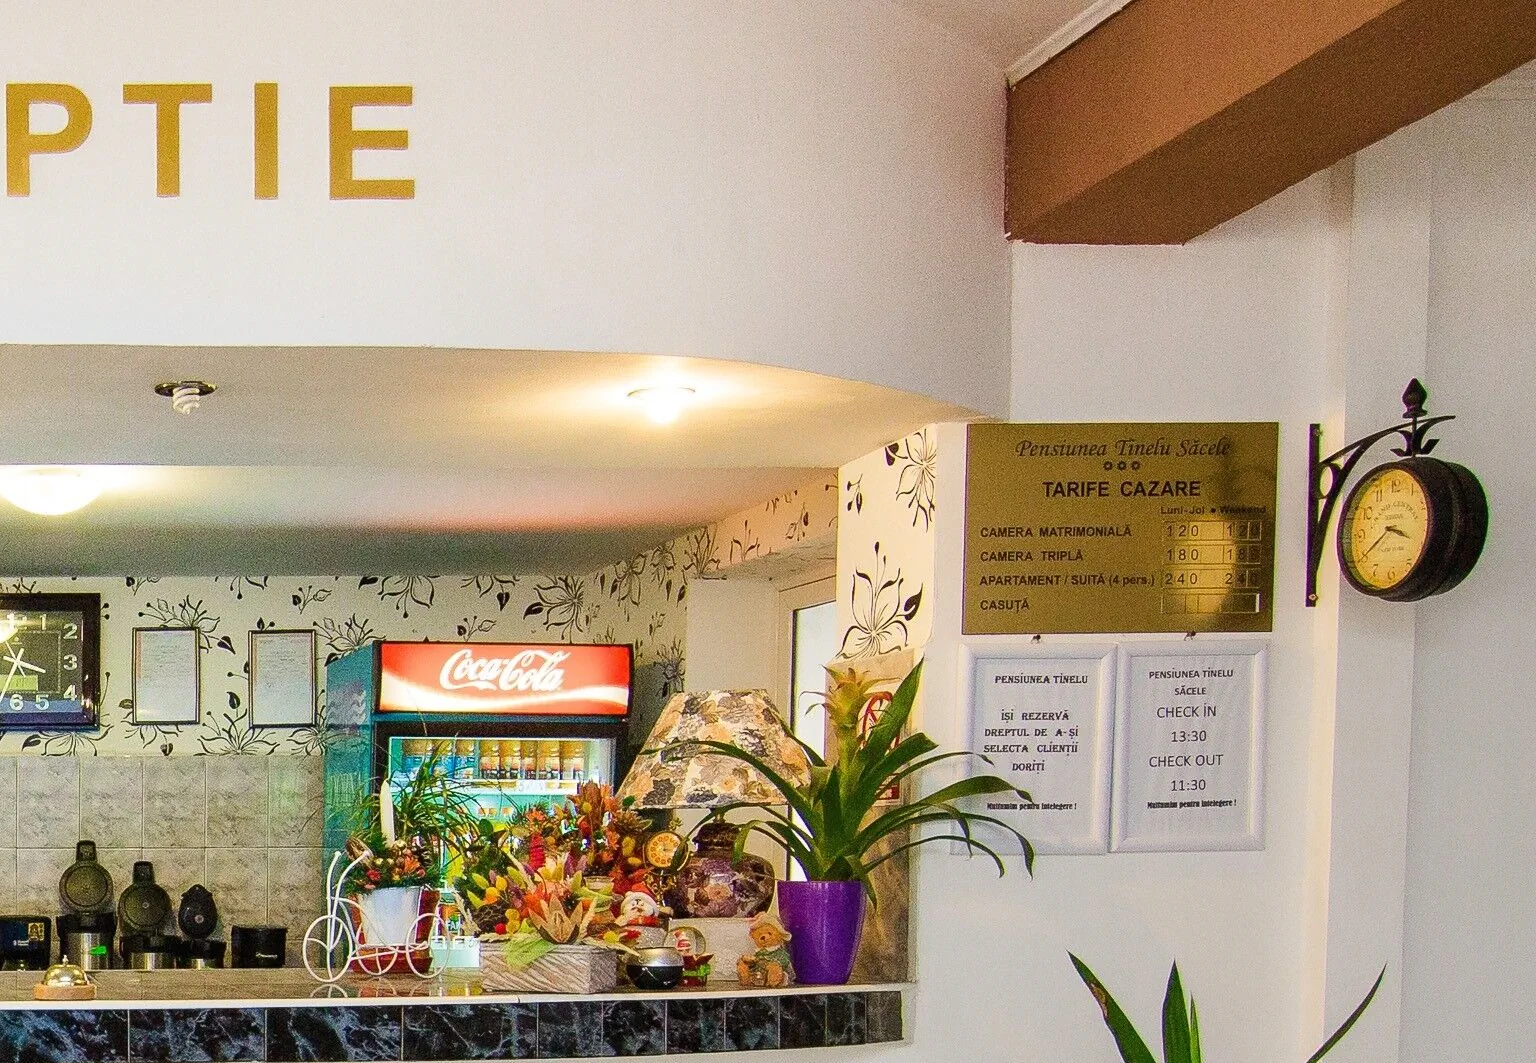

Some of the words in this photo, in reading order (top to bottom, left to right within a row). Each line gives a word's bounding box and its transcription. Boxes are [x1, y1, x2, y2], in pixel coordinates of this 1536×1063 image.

[1016, 439, 1107, 456] Pensiunea
[1042, 481, 1110, 497] TARIFE
[1120, 480, 1201, 497] CAZARE
[980, 526, 1033, 538] CAMERA
[980, 550, 1033, 562] CAMERA
[979, 574, 1061, 586] APARTAMENT
[63, 622, 78, 640] 2
[63, 653, 78, 671] 3
[439, 648, 572, 692] Coca-Cola
[63, 684, 78, 702] 4
[9, 693, 24, 711] 6
[35, 694, 50, 711] 5
[1156, 706, 1199, 719] CHECK
[984, 728, 1030, 737] DREPTUL
[1034, 728, 1048, 737] DE
[1171, 730, 1207, 743] 13:30
[983, 744, 1029, 753] SELECTA
[1149, 755, 1192, 768] CHECK
[1195, 754, 1224, 767] OUT
[1171, 779, 1206, 792] 11:30
